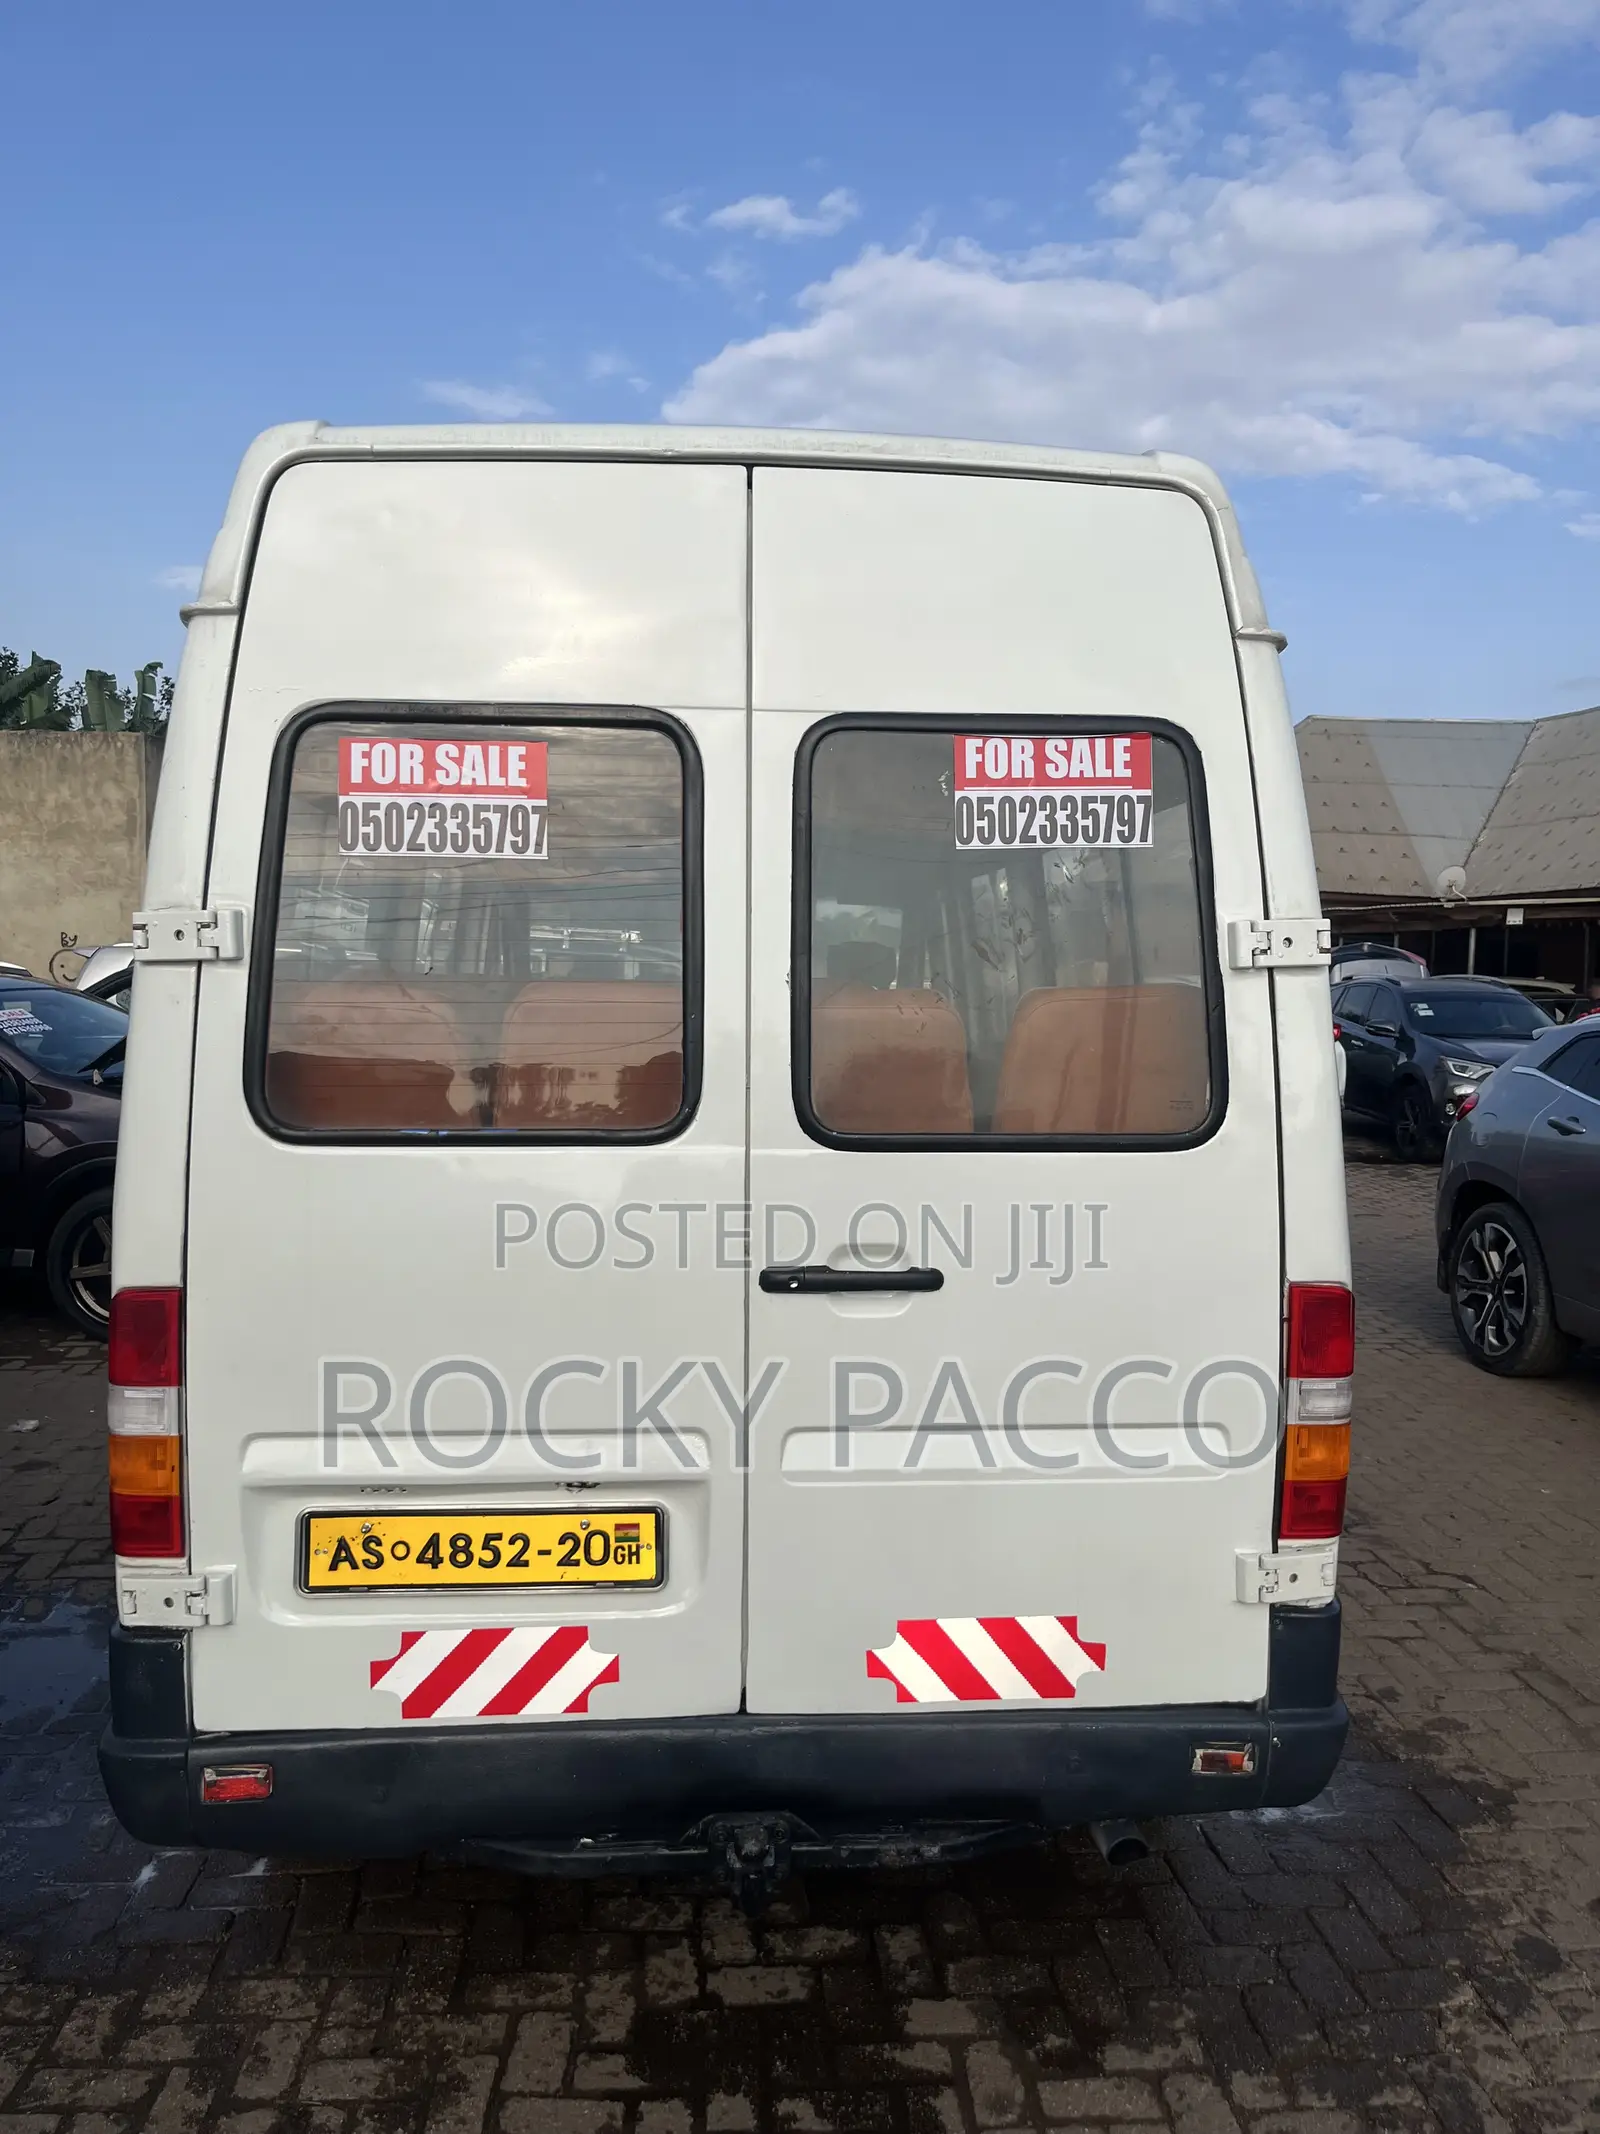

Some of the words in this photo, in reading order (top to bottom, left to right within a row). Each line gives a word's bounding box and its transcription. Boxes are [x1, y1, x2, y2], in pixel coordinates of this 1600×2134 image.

[350, 742, 424, 785] FOR
[435, 743, 528, 787] SALE
[964, 738, 1034, 779] FOR
[1045, 738, 1132, 779] SALE
[339, 800, 548, 855] 0502335797
[955, 795, 1152, 845] 0502335797
[328, 1535, 384, 1571] AS
[416, 1529, 610, 1570] 4852-20
[613, 1544, 641, 1565] GH
